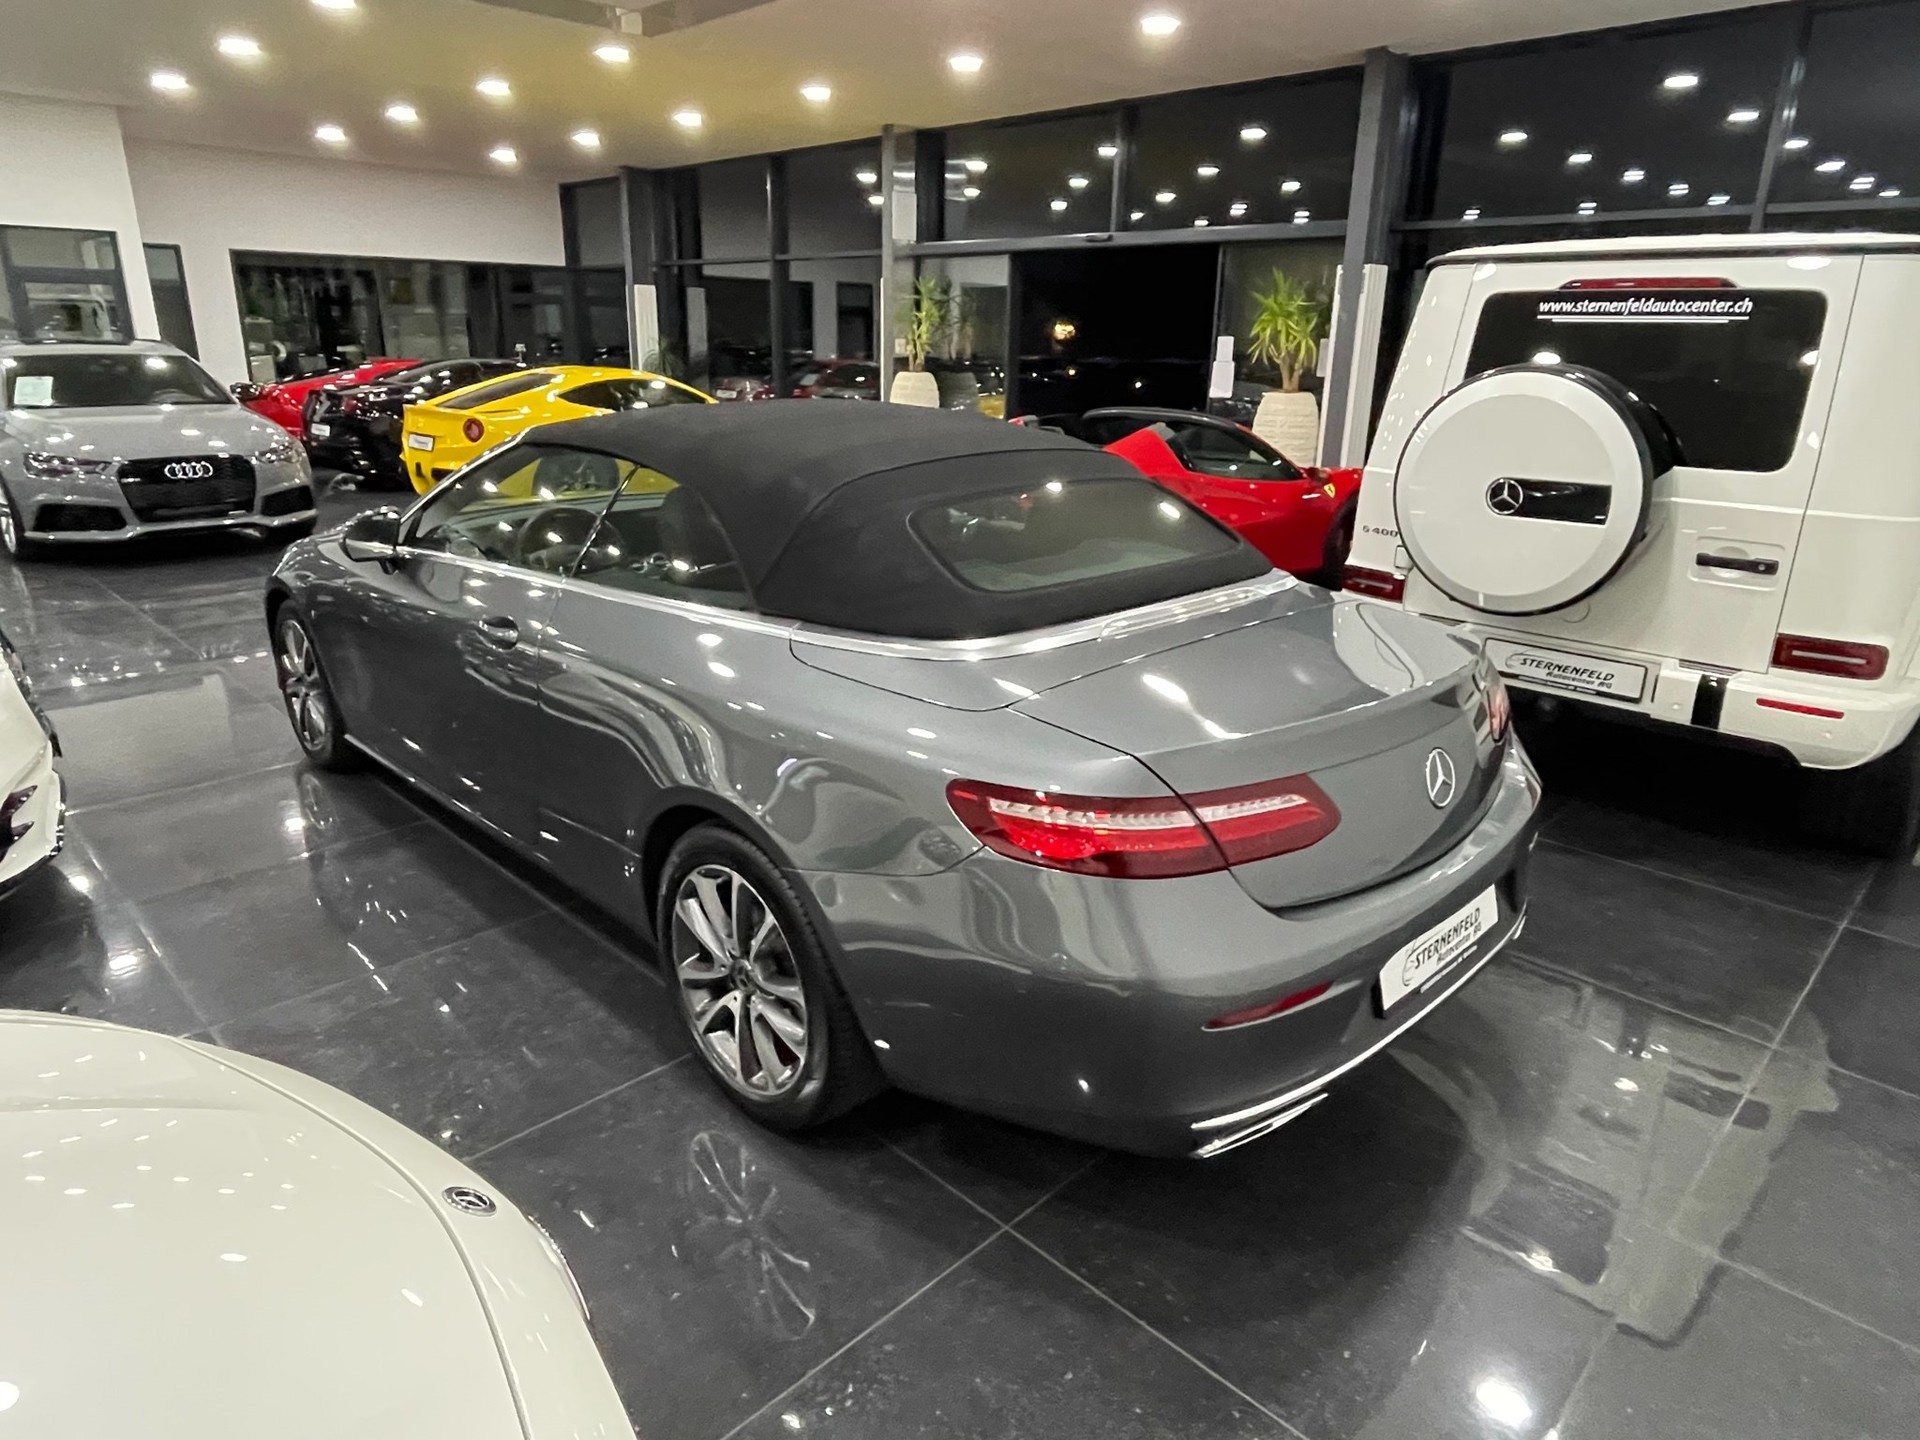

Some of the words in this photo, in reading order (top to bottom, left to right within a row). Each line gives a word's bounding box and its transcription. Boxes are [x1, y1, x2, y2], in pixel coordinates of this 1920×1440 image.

[1539, 297, 1753, 316] www.sternenfeldautocenter.ch
[1371, 527, 1398, 537] 400
[1520, 657, 1614, 681] STERNENFELD
[1414, 907, 1480, 970] STERNENFELD
